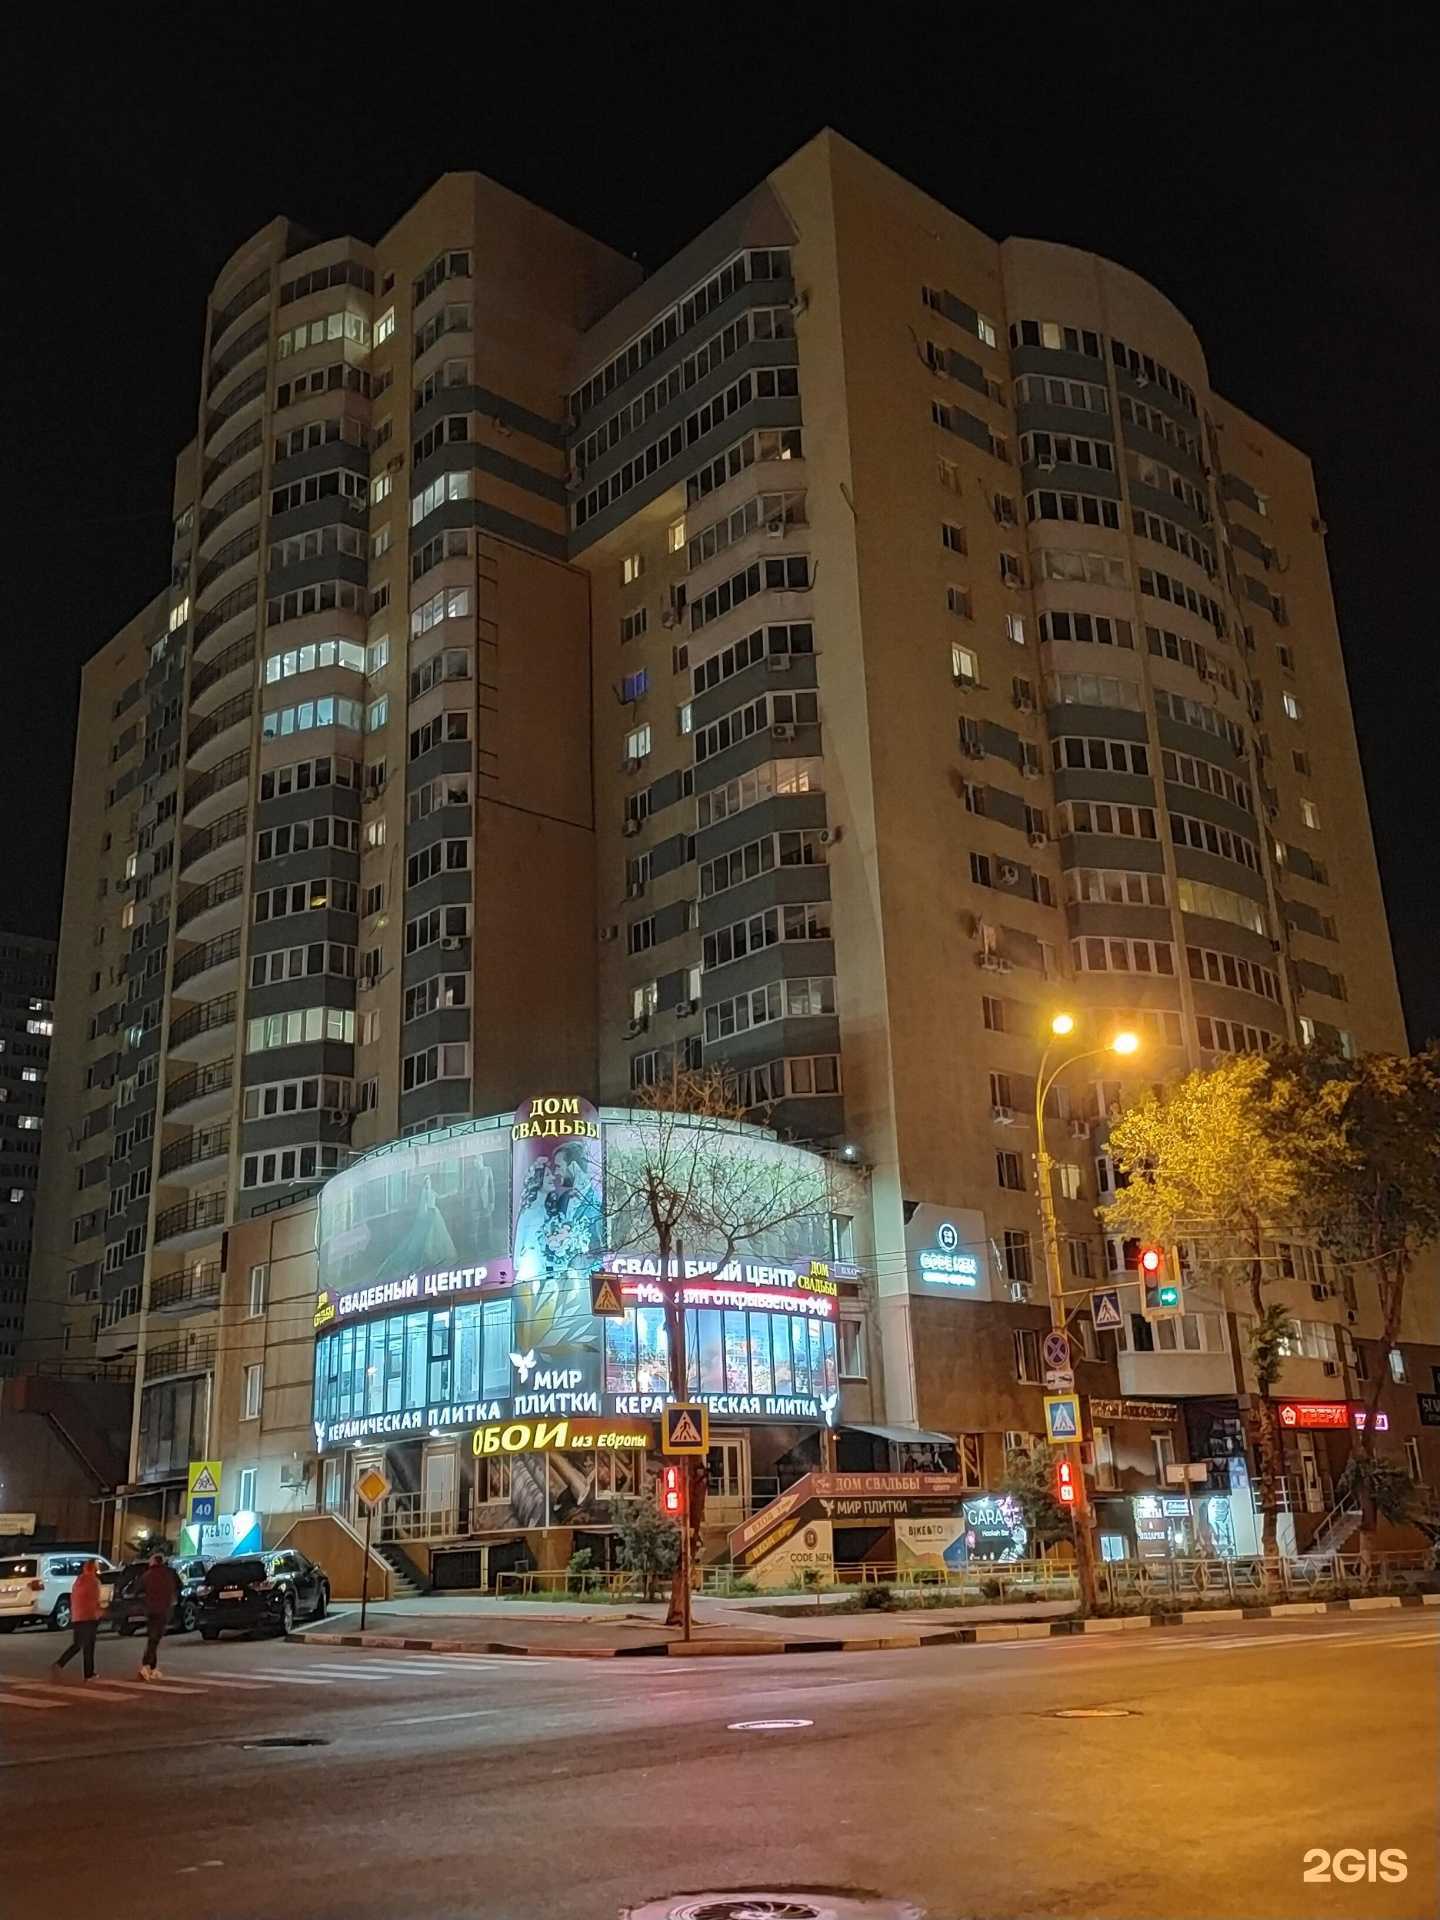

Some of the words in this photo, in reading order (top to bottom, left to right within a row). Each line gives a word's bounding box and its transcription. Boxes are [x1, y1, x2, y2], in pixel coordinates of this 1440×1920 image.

[530, 1098, 579, 1118] ДОМ
[512, 1119, 600, 1140] СВАДЬБЫ
[747, 1268, 796, 1289] ЦЕНТР
[811, 1261, 829, 1277] ДОМ
[339, 1273, 418, 1314] СВАДЕБНЫЙ
[424, 1267, 488, 1296] ЦЕНТР
[798, 1275, 837, 1296] СВАДЬБЫ
[533, 1370, 583, 1391] МИР
[514, 1392, 597, 1416] ПЛИТКИ
[766, 1397, 818, 1417] ПЛИТКА
[328, 1414, 422, 1442] КЕРАМИЧЕСКАЯ
[428, 1401, 501, 1427] ПЛИТКА
[472, 1421, 569, 1456] ОБОИ
[571, 1434, 592, 1448] из
[597, 1432, 646, 1450] Европы
[835, 1477, 862, 1491] ДОМ
[865, 1477, 920, 1491] СВАДЬБЫ
[195, 1503, 212, 1516] 40
[837, 1501, 861, 1514] МИР
[864, 1500, 908, 1514] ПЛИТКИ
